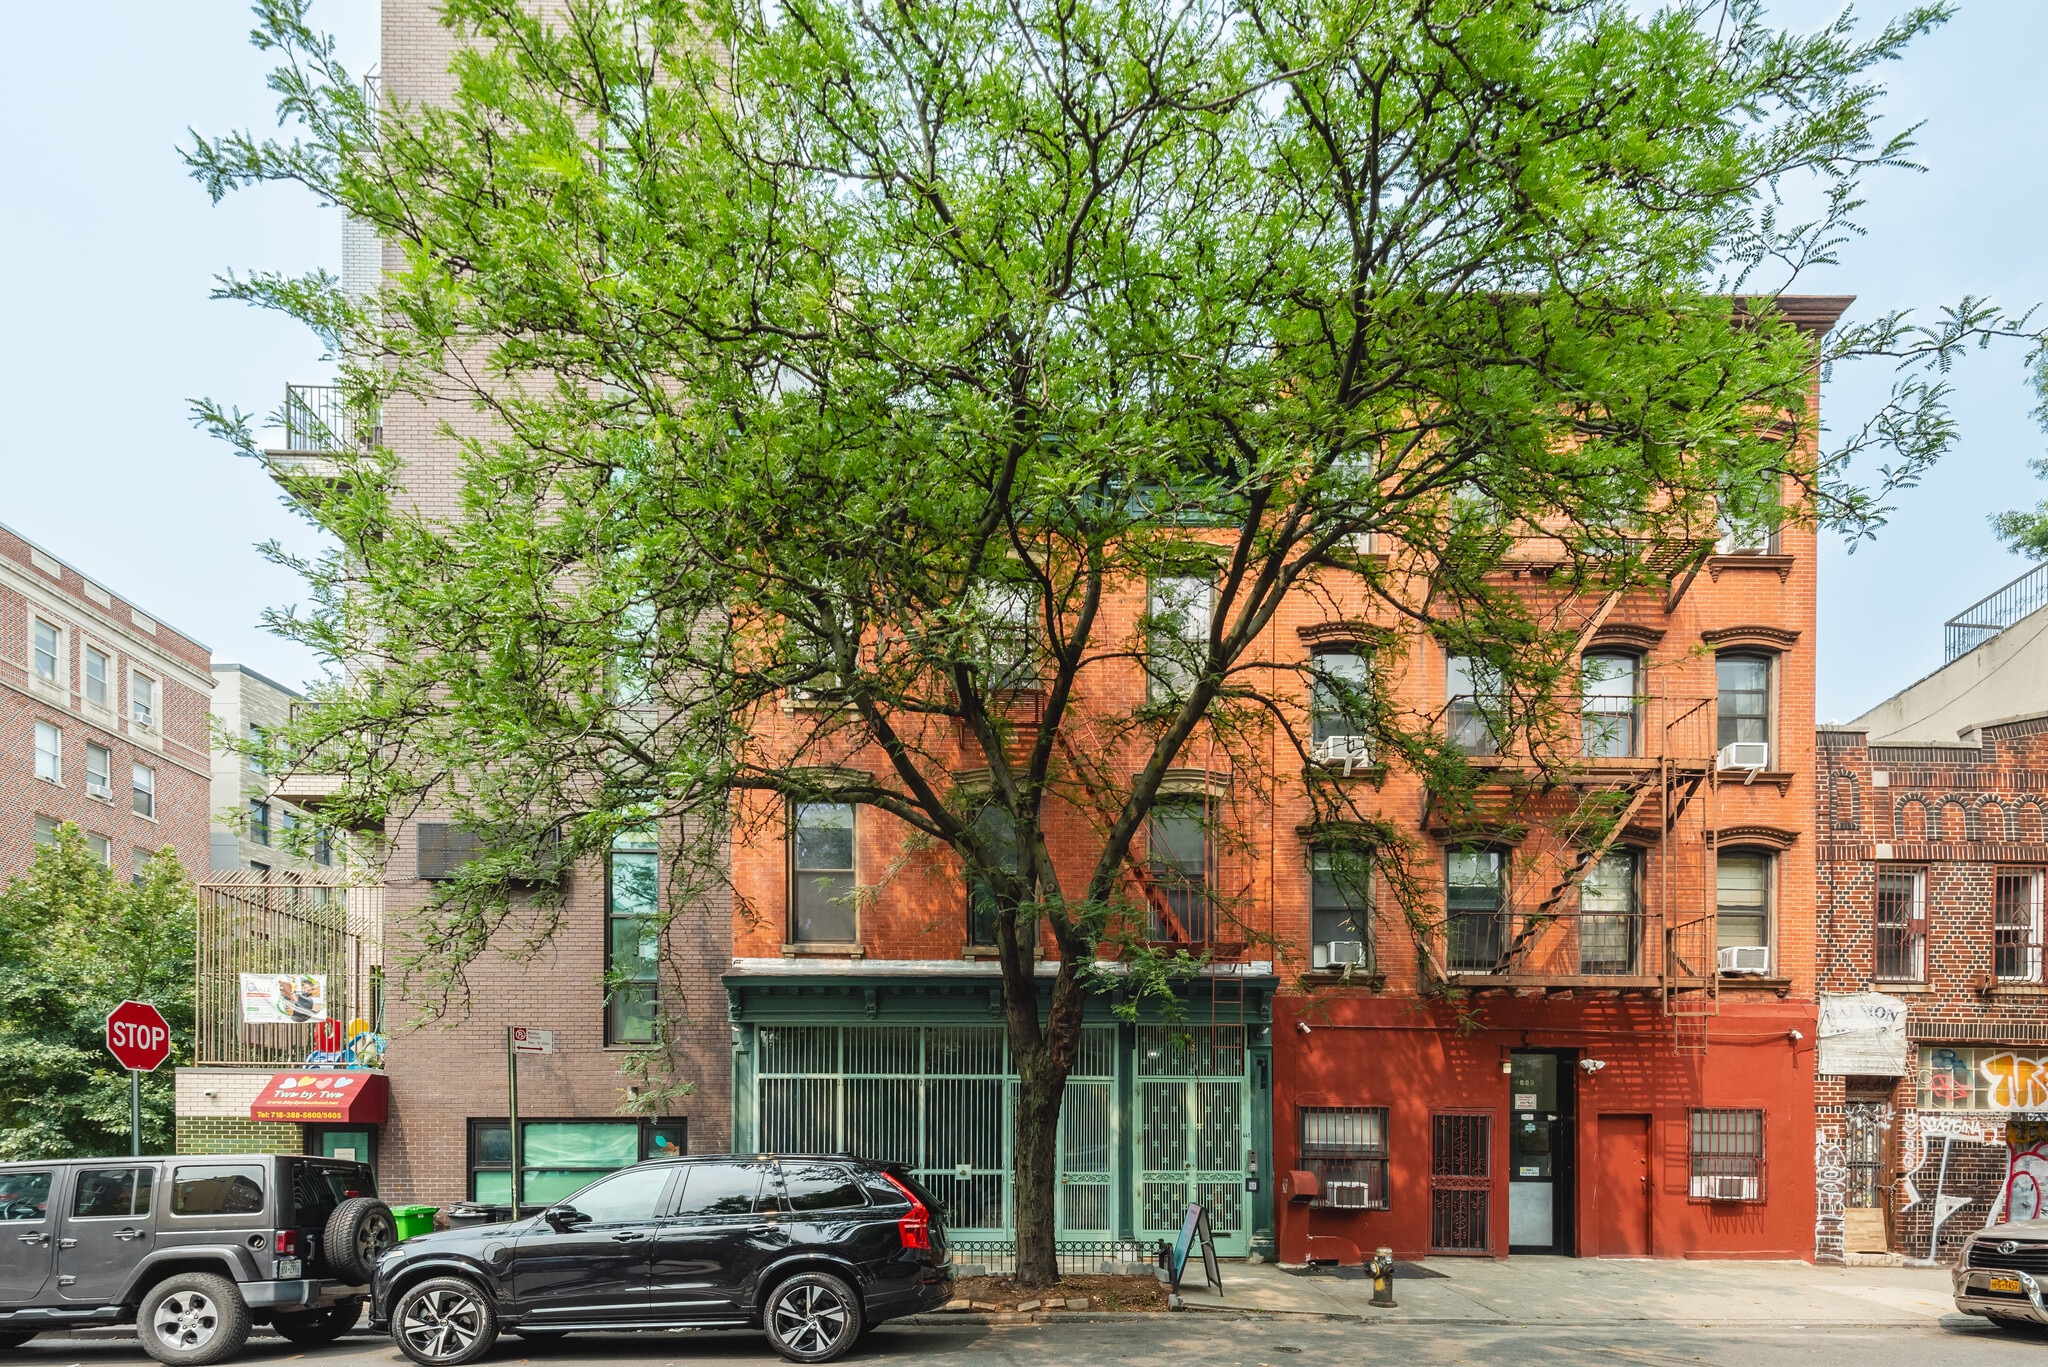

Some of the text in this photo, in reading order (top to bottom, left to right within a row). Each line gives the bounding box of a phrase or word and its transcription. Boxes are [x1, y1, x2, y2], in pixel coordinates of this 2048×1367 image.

[112, 1021, 165, 1051] STOP
[273, 1090, 345, 1100] Two by Two
[271, 1111, 342, 1119] 718-388-5600/5605
